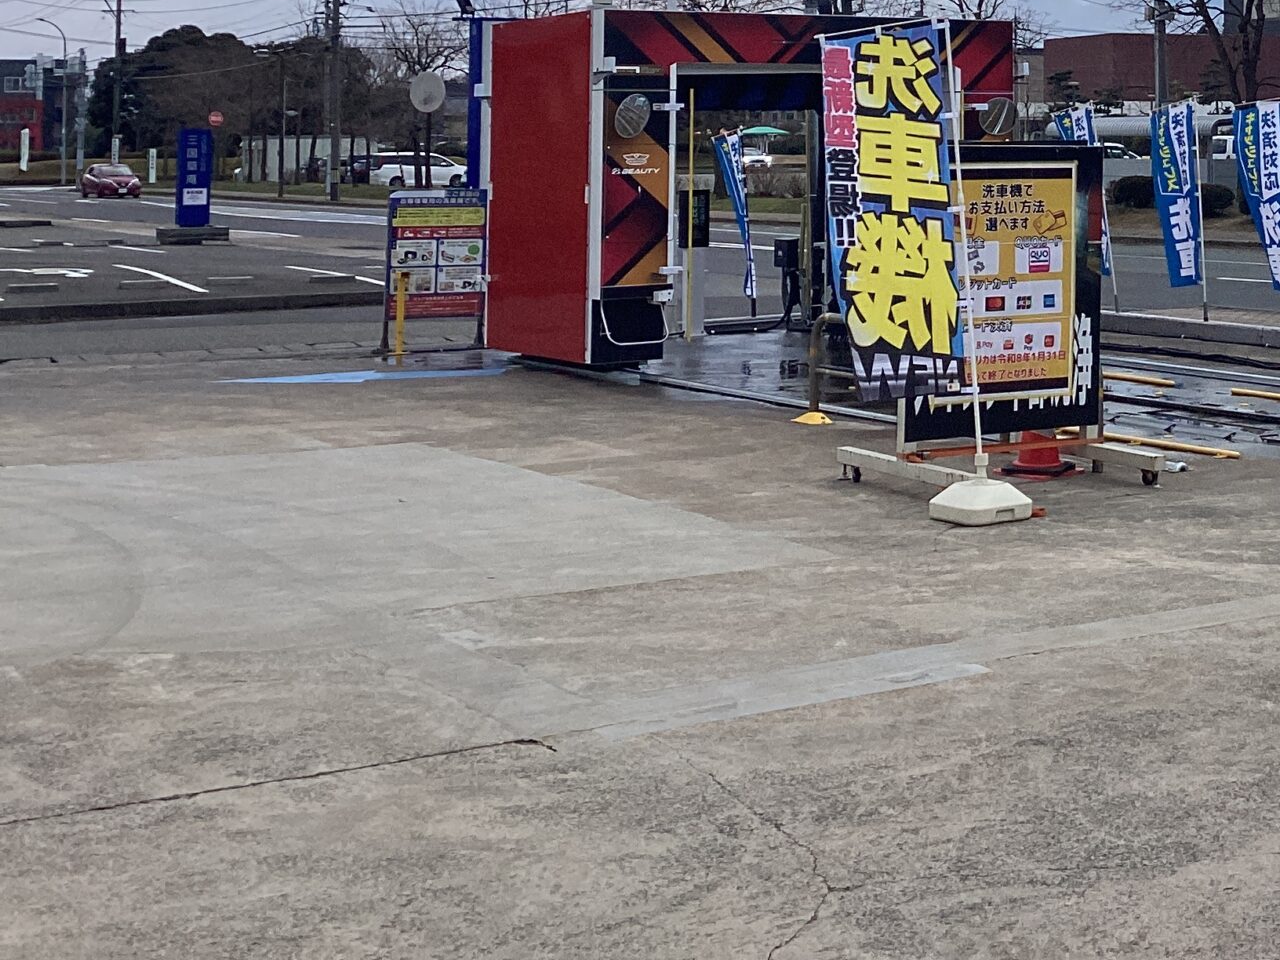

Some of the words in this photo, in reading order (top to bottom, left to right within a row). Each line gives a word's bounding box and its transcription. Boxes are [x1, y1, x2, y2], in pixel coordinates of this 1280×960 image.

[622, 167, 660, 175] BEAUTY
[982, 184, 1033, 198] 洗車機で
[968, 200, 1046, 215] お支払い方法
[1030, 249, 1049, 260] QUO
